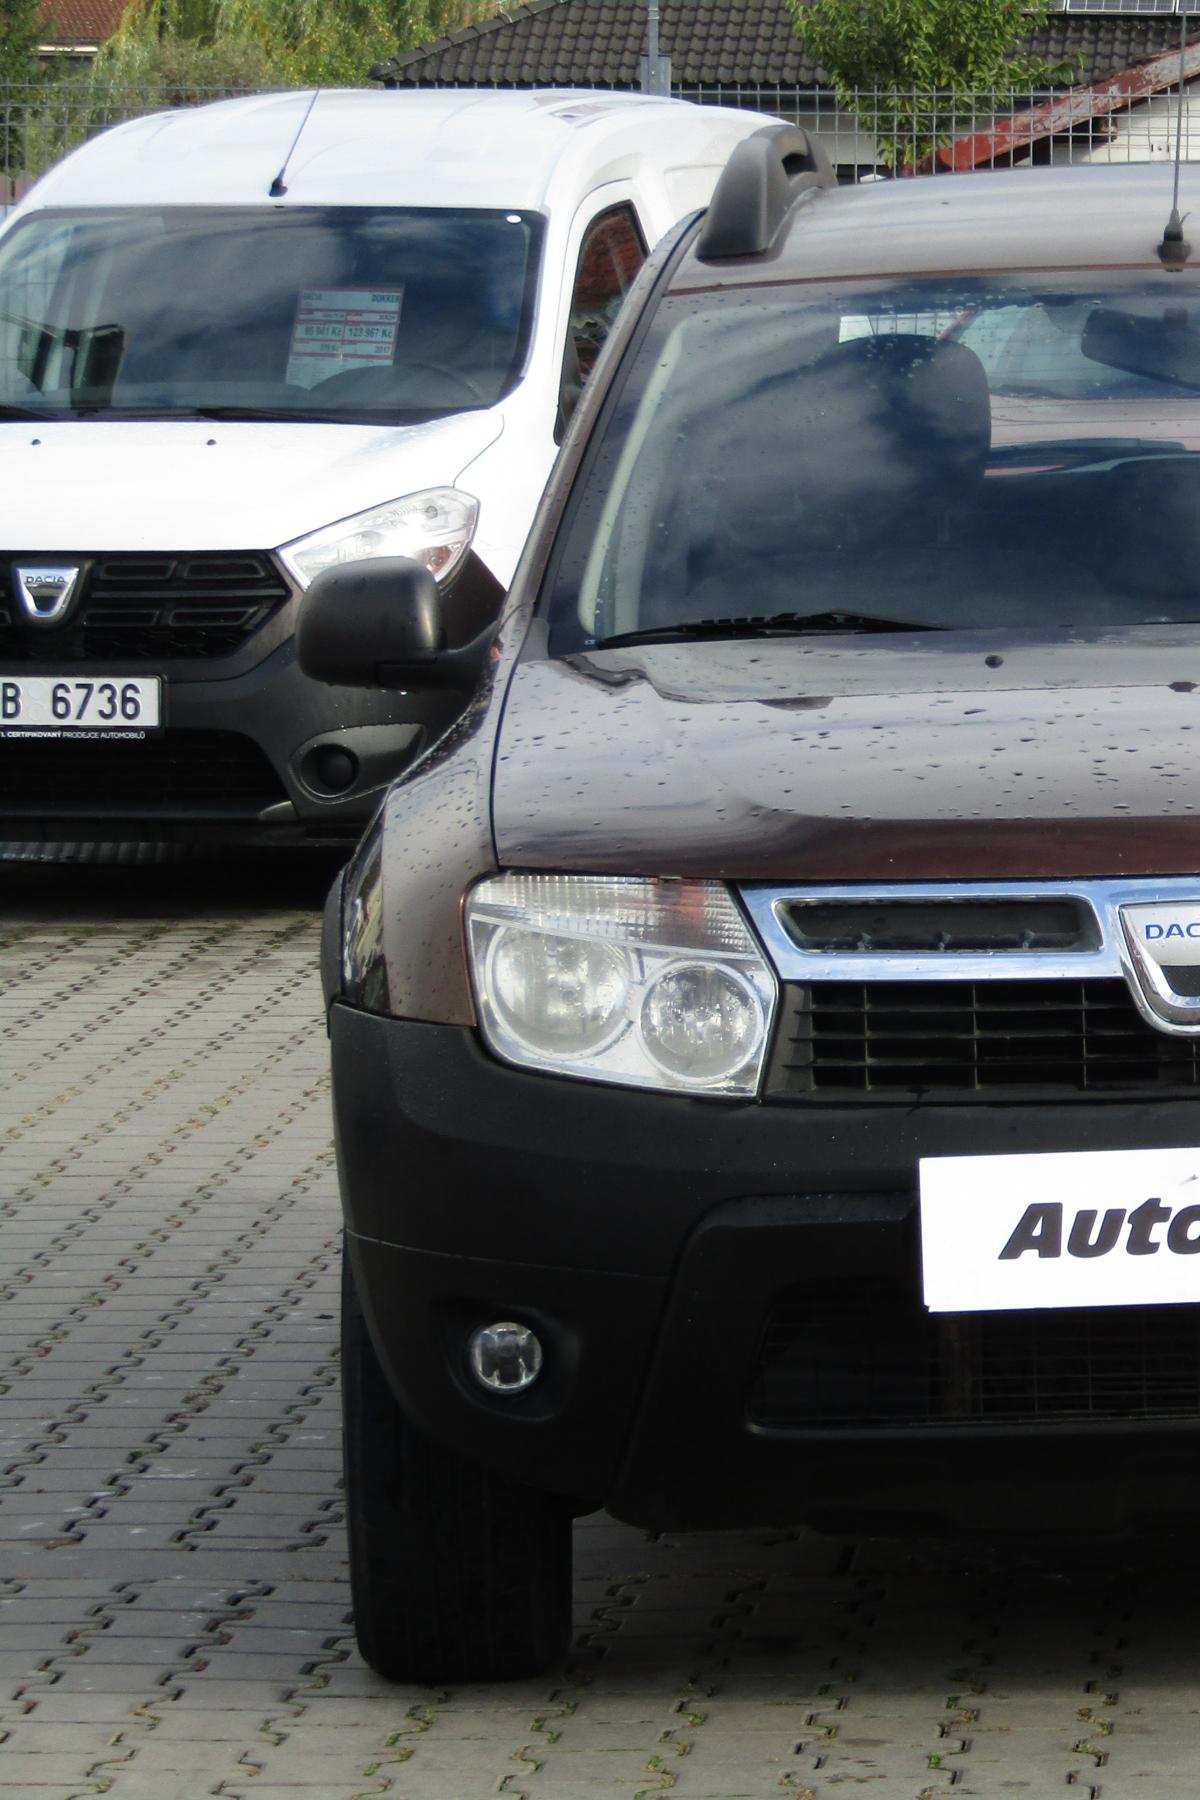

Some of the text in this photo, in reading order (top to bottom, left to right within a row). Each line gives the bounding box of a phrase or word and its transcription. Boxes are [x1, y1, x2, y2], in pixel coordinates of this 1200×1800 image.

[371, 294, 400, 303] DOKKER
[26, 576, 66, 584] DACIA
[52, 683, 141, 720] 6736
[7, 730, 61, 738] CERTIFIKOVANÝ
[62, 731, 99, 739] PRODEJCE
[100, 731, 146, 739] AUTOMOBILŮ
